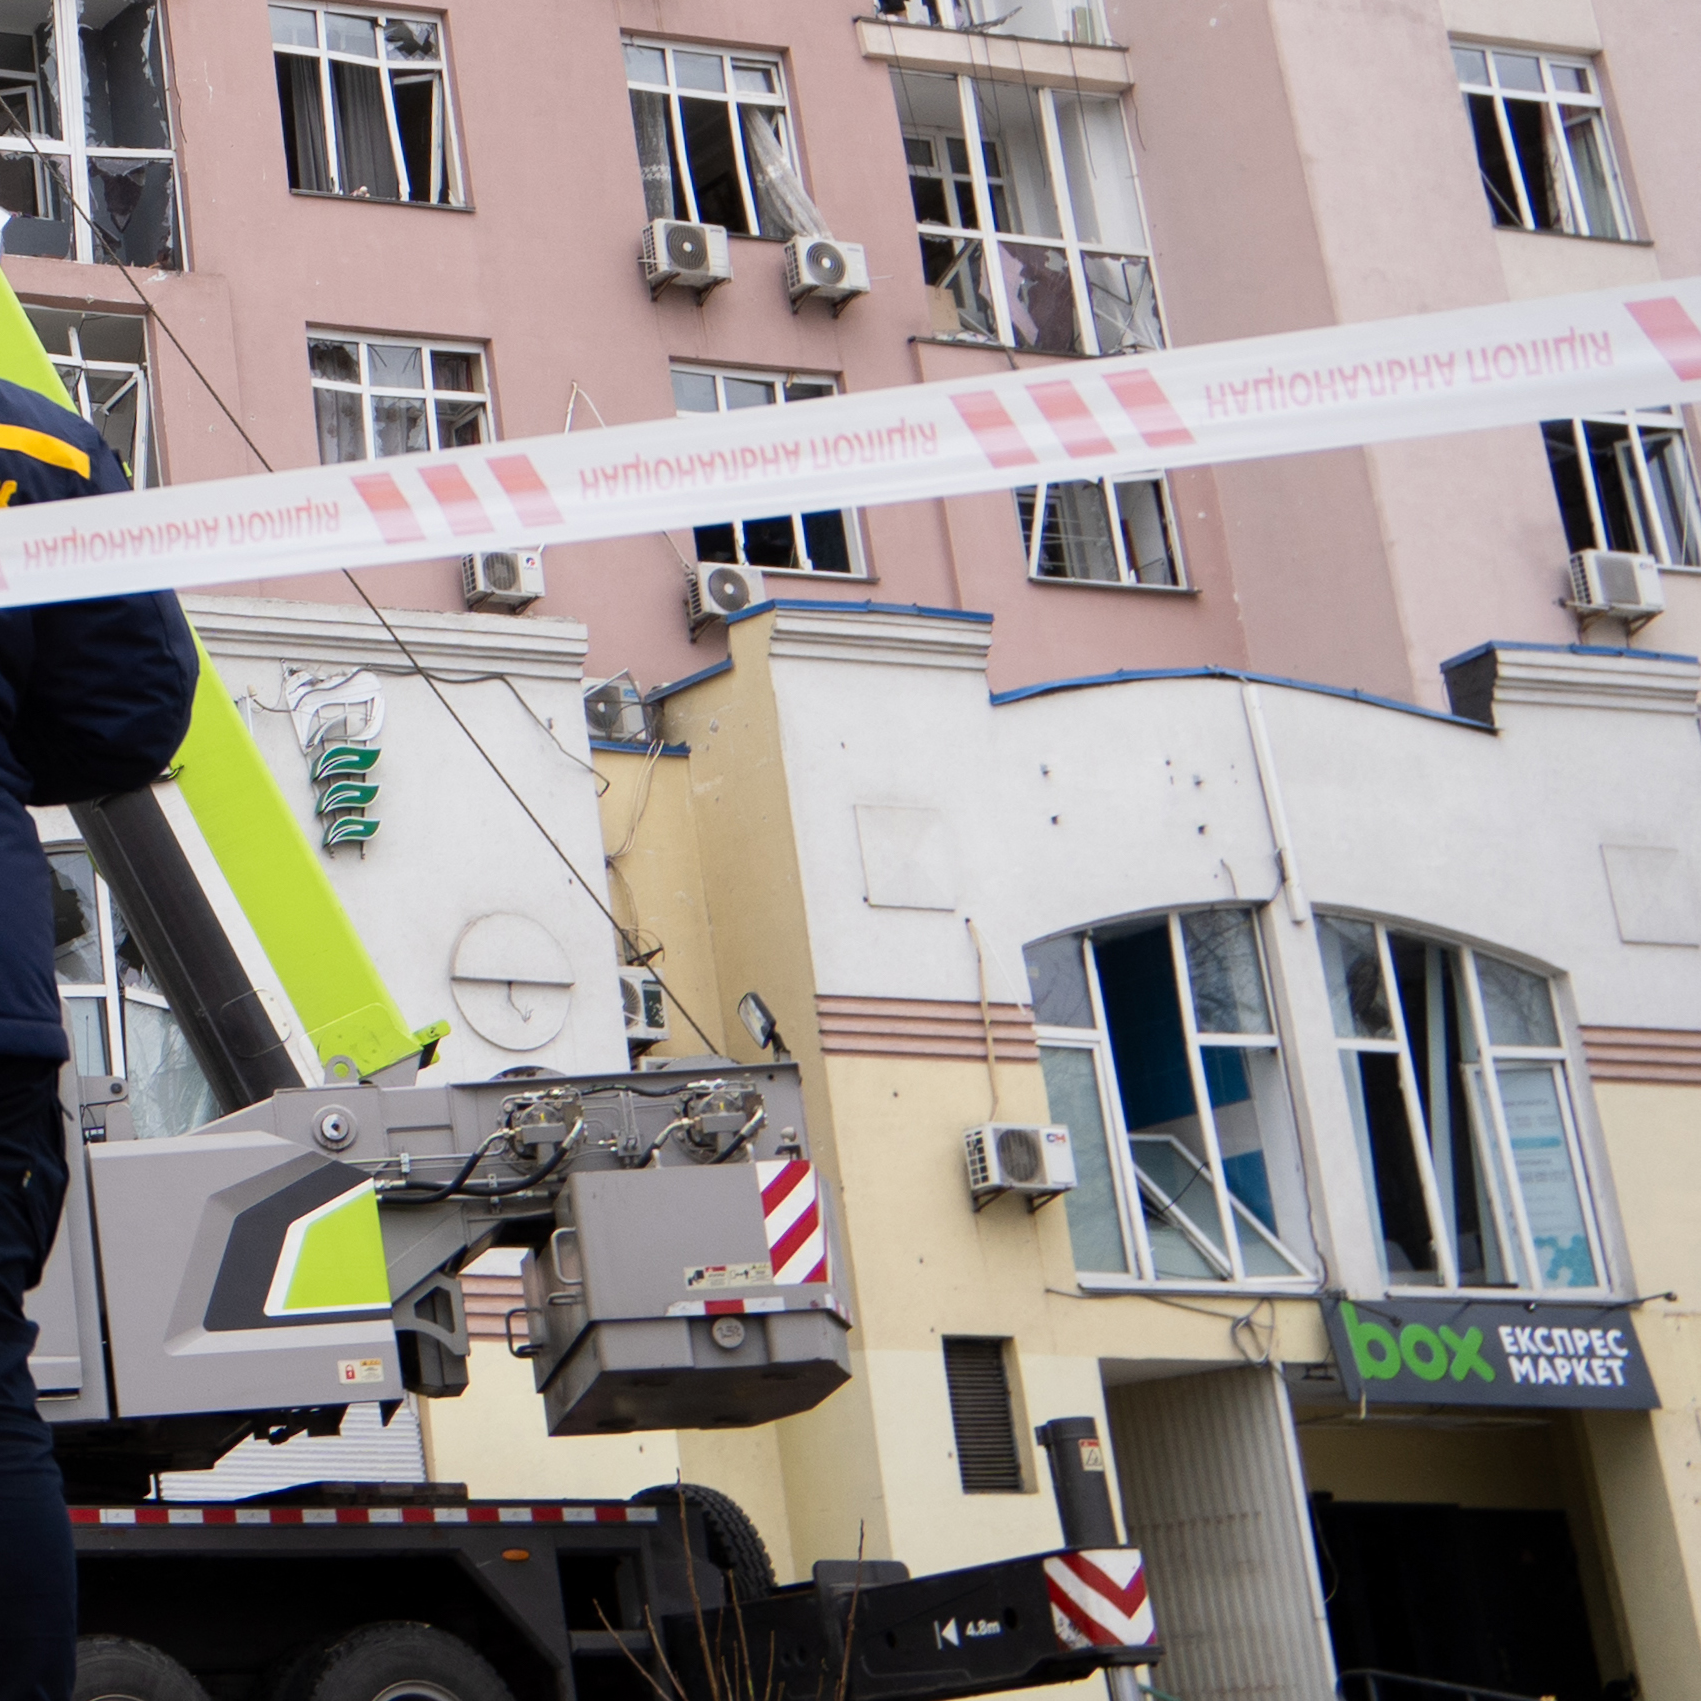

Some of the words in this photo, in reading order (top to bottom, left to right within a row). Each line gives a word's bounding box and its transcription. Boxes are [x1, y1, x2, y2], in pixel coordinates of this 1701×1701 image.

[1339, 1300, 1496, 1383] box
[1498, 1325, 1629, 1358] ЕКСПРЕС
[1508, 1356, 1626, 1387] МАРКЕТ
[965, 1619, 1001, 1637] 4.8m
